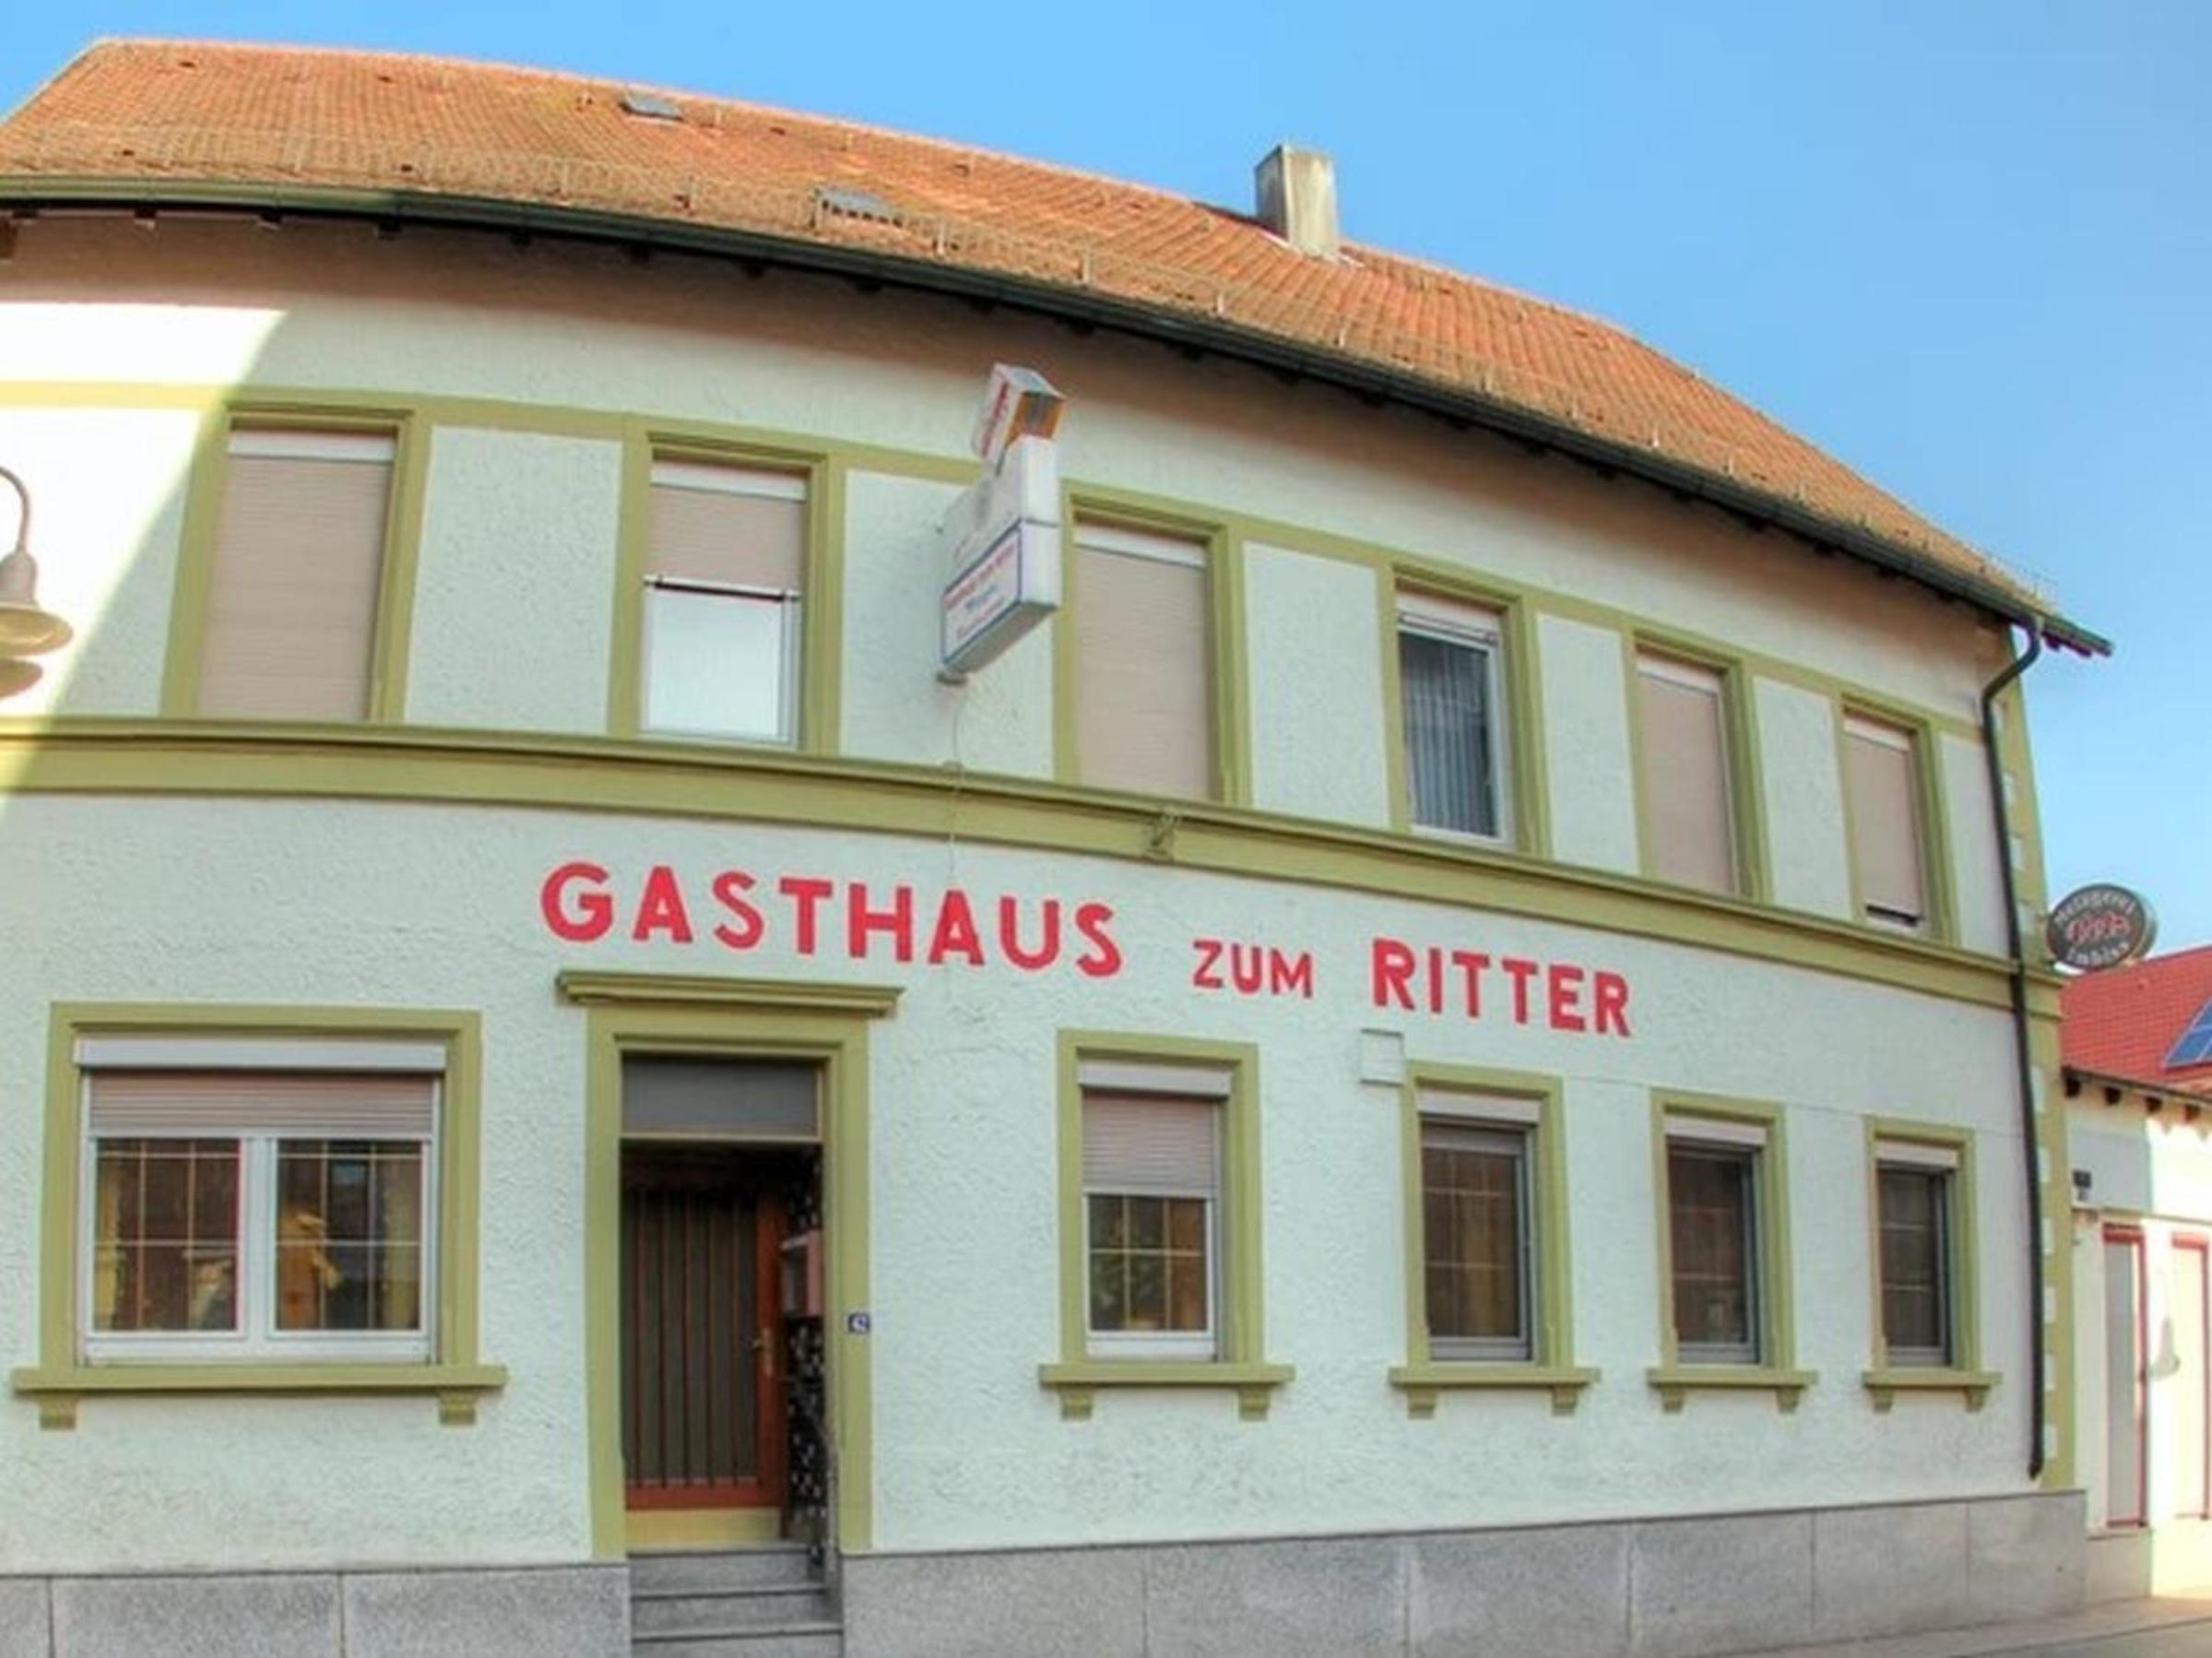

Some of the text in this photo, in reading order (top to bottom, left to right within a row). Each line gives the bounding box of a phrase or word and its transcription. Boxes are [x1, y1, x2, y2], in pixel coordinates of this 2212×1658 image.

[540, 862, 1631, 1038] GASTHAUS ZUM RITTER
